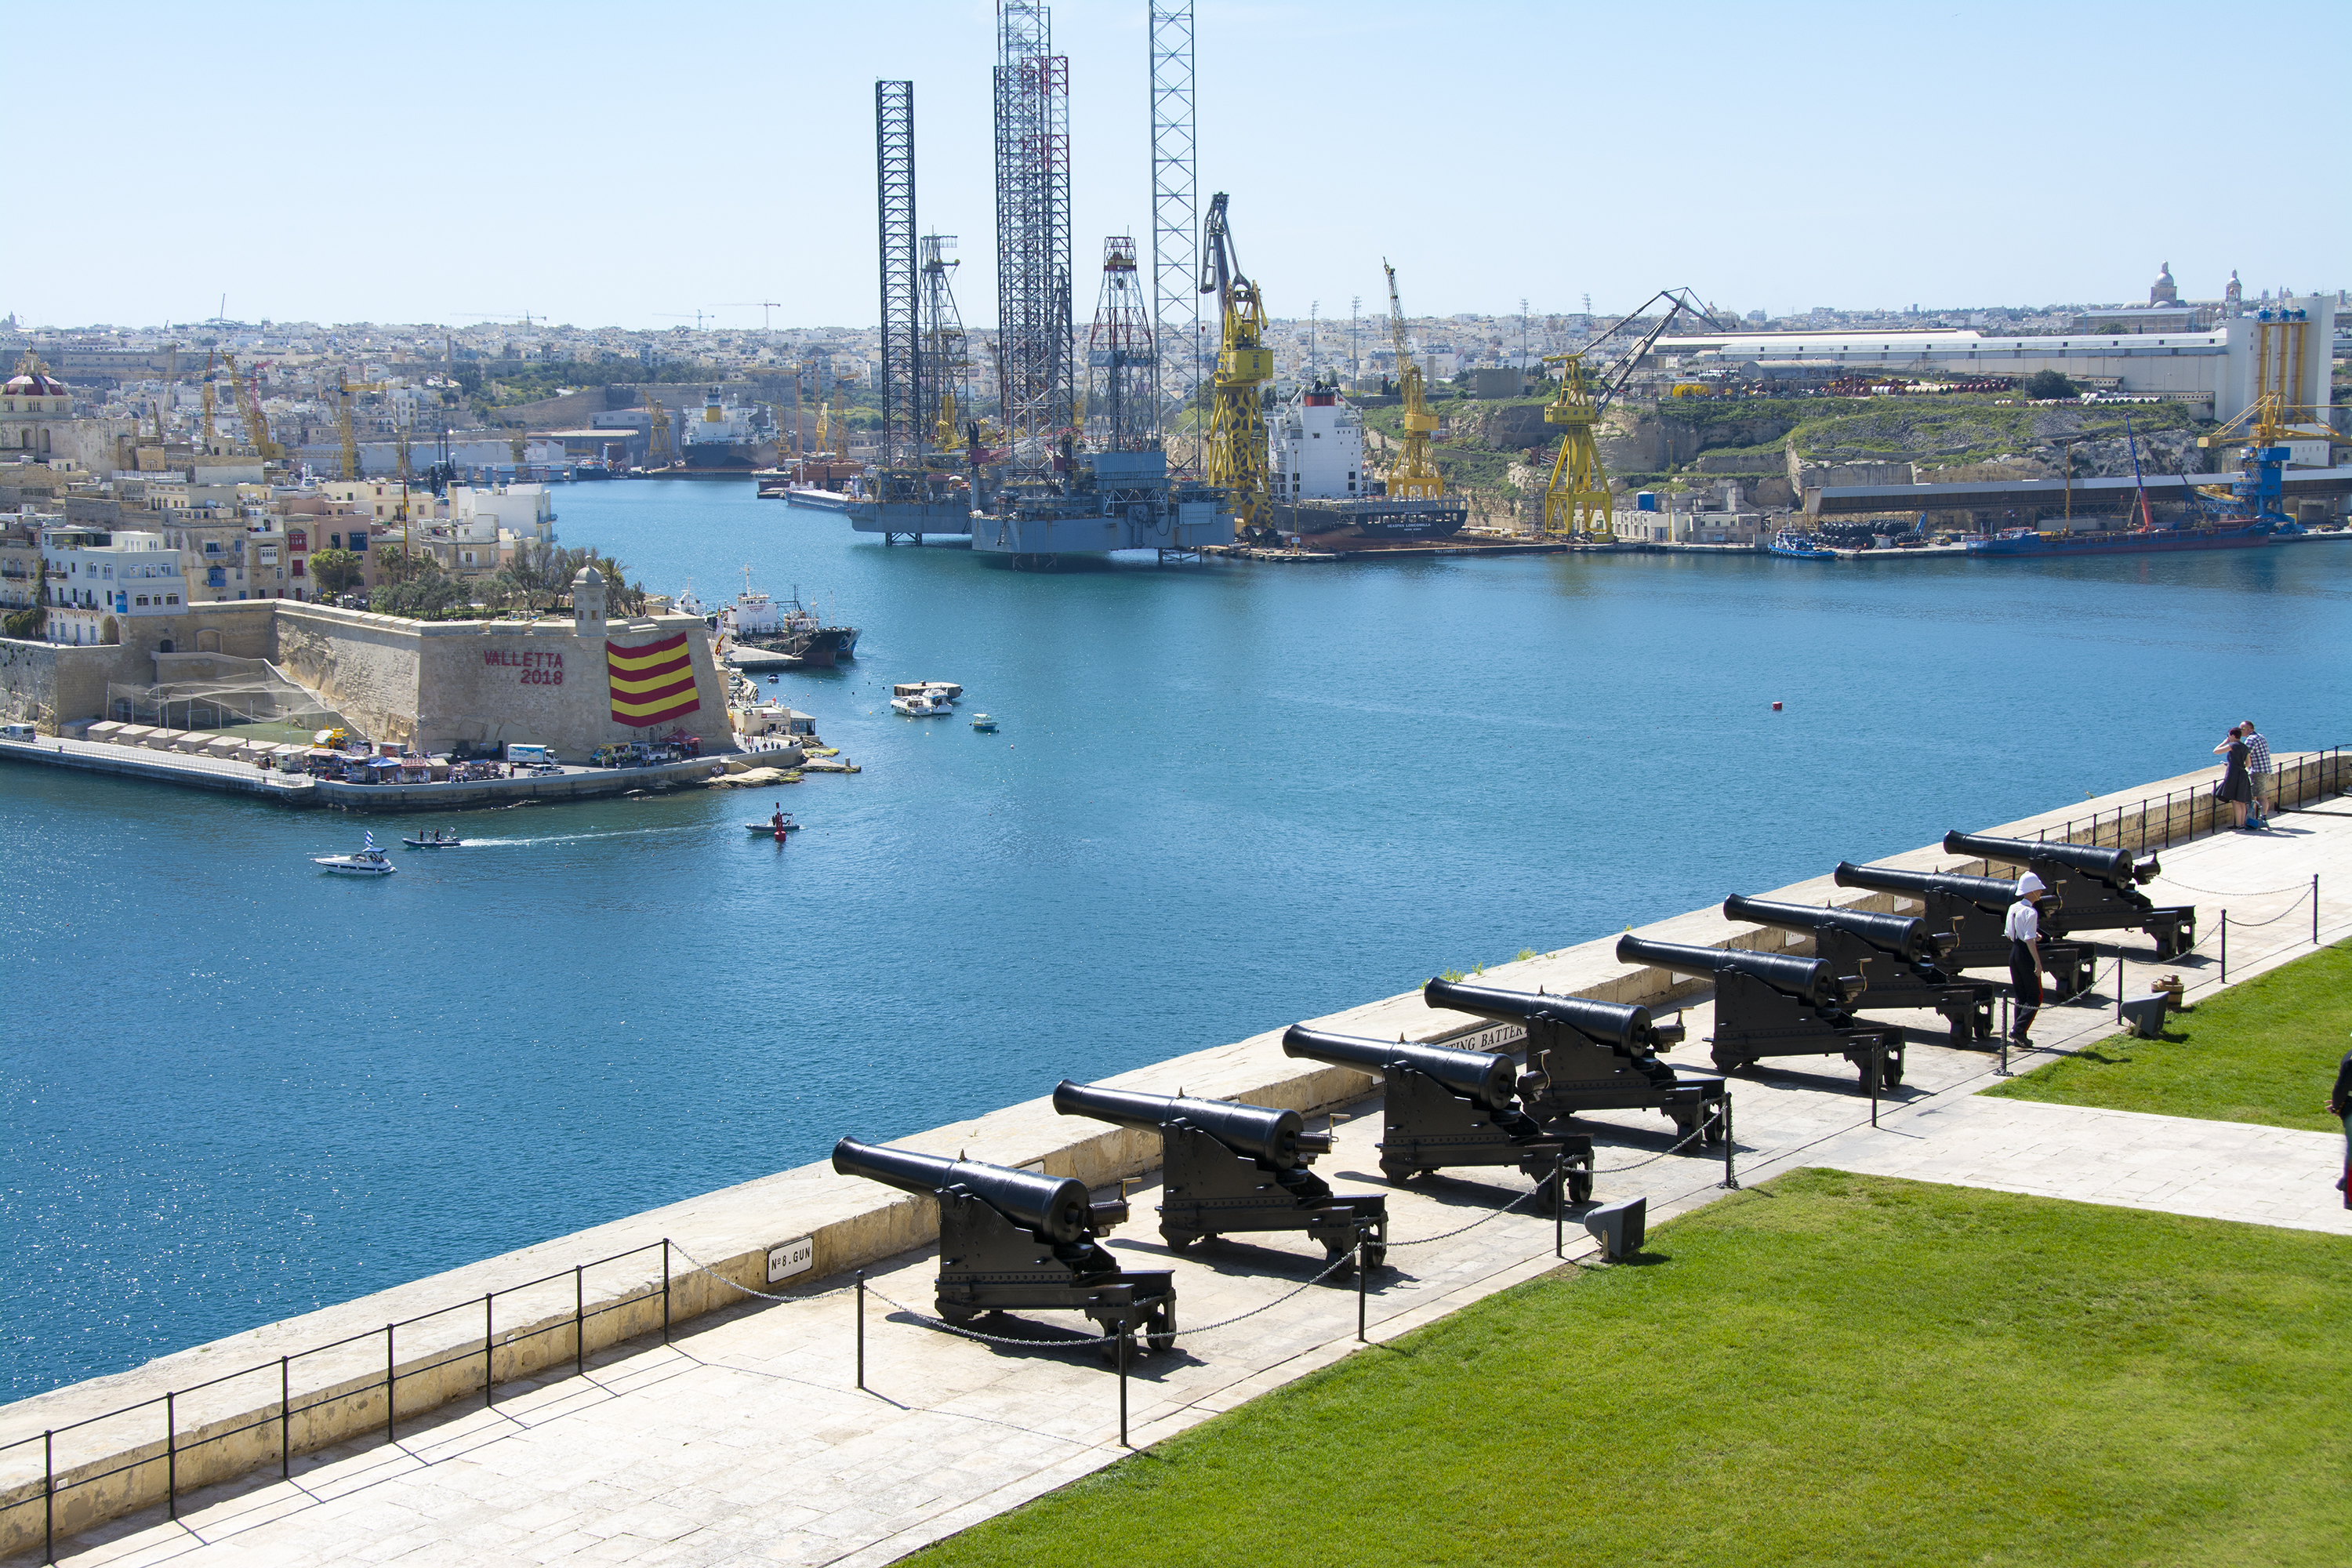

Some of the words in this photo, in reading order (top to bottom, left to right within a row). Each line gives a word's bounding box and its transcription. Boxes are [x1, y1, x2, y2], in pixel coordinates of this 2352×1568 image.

[484, 650, 563, 668] VALLETTA
[521, 669, 563, 685] 2018
[1480, 1025, 1527, 1047] BATTER
[793, 1247, 810, 1262] GUN
